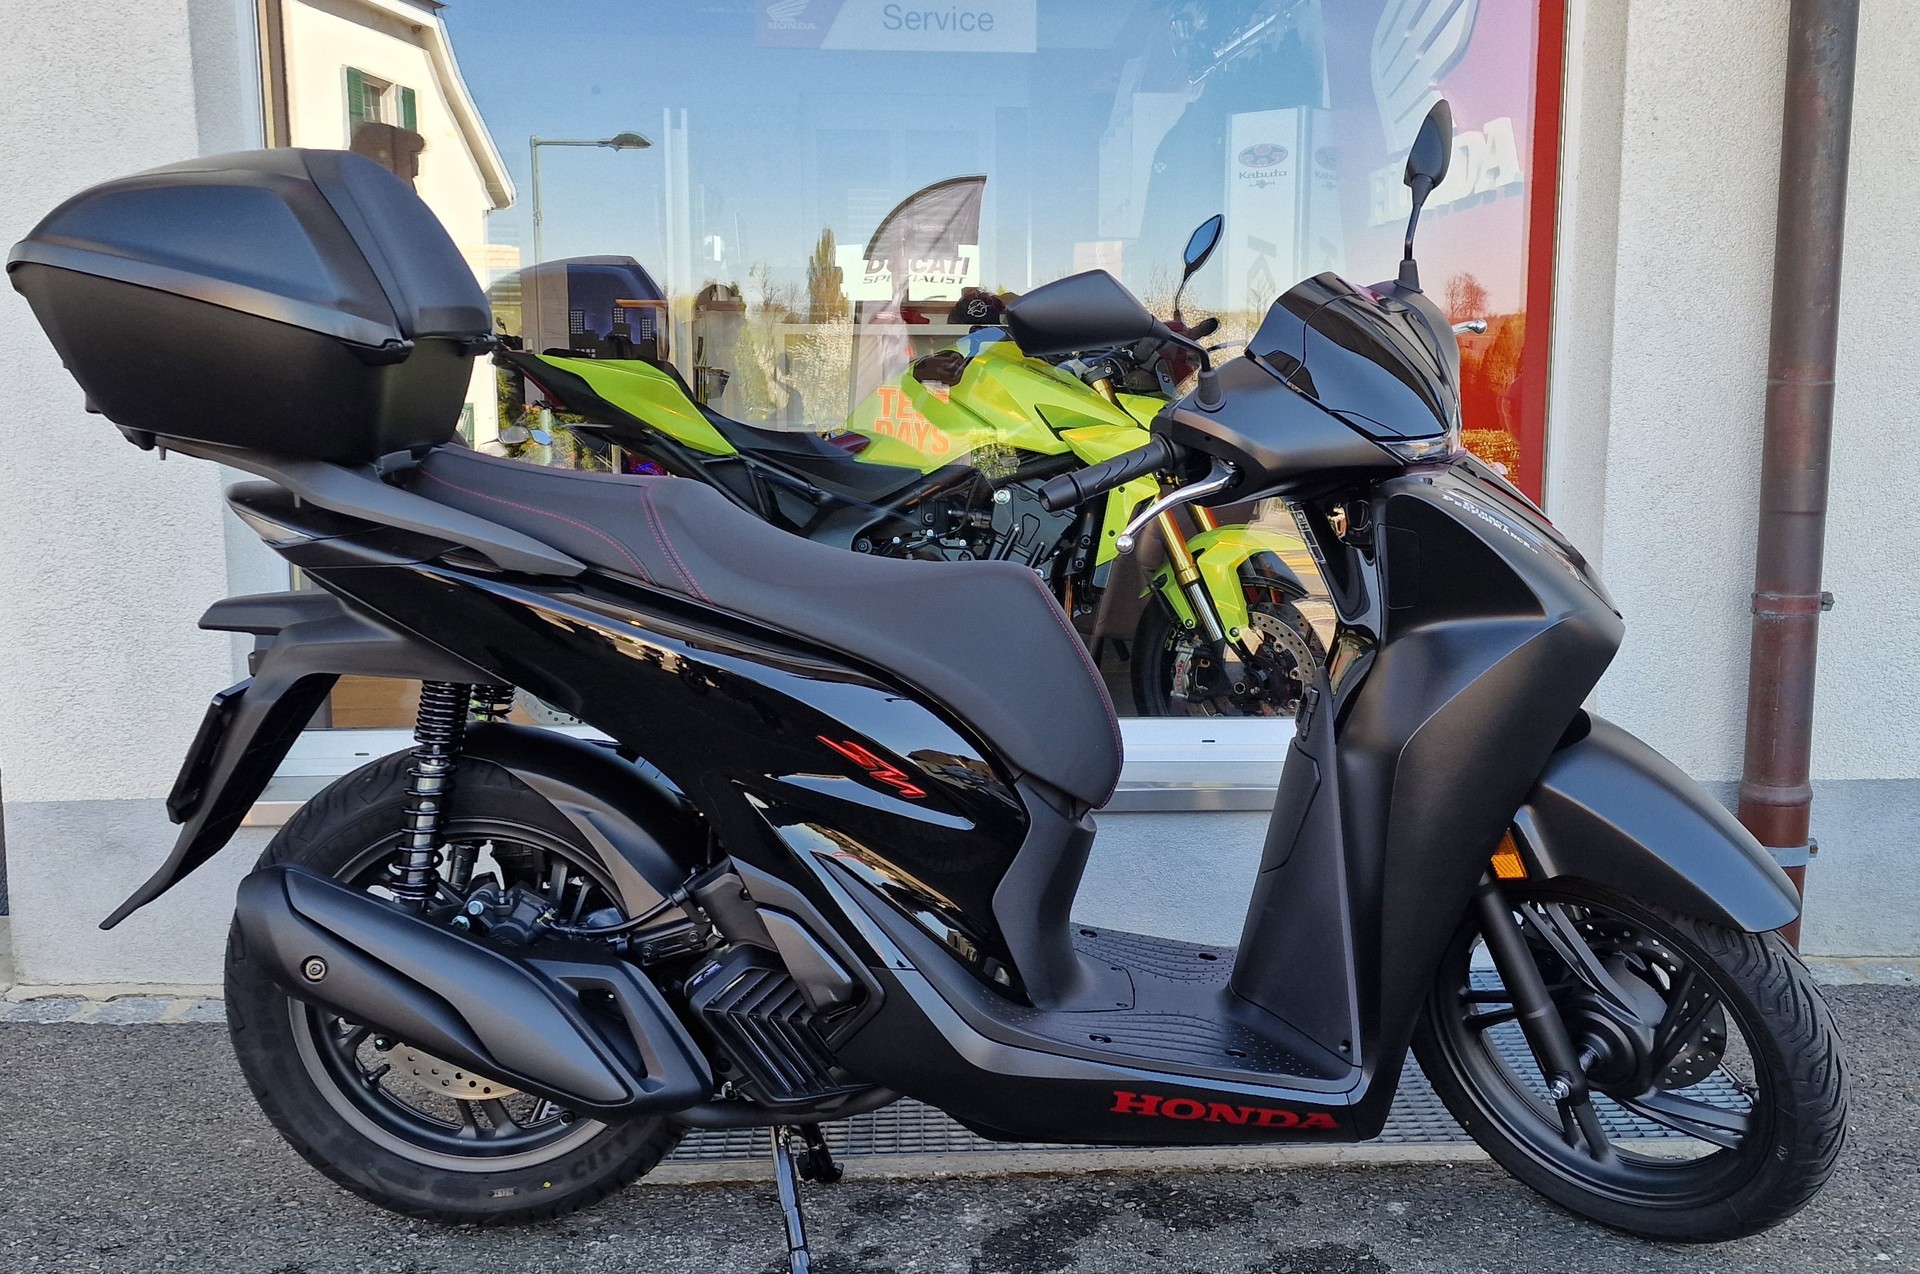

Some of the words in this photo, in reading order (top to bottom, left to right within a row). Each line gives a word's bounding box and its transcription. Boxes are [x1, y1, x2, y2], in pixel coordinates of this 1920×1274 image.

[767, 20, 818, 31] HONDA
[882, 4, 995, 32] Service
[1368, 117, 1525, 228] HDA
[1109, 1090, 1342, 1129] HONDA
